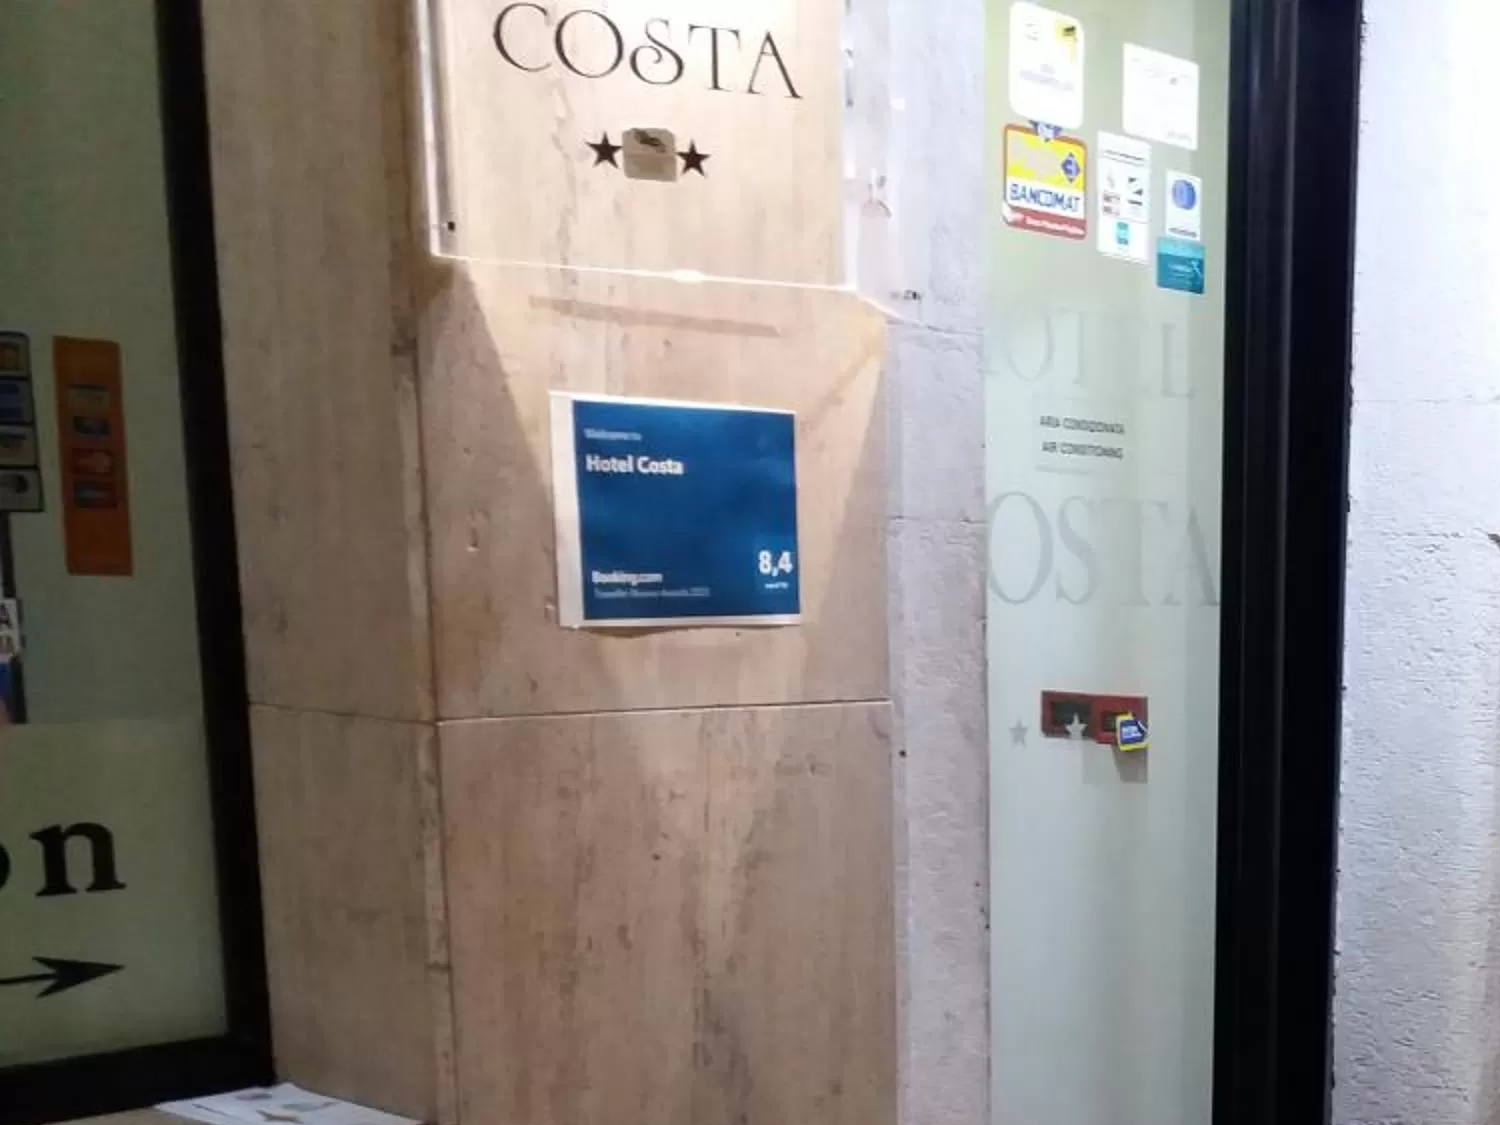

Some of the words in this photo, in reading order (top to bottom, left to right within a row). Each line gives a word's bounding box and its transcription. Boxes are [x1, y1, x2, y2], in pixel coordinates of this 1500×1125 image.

[493, 2, 803, 100] COSTA
[585, 454, 634, 473] Hotel
[636, 455, 685, 475] Costa
[758, 550, 793, 577] 8,4
[0, 822, 128, 896] n
